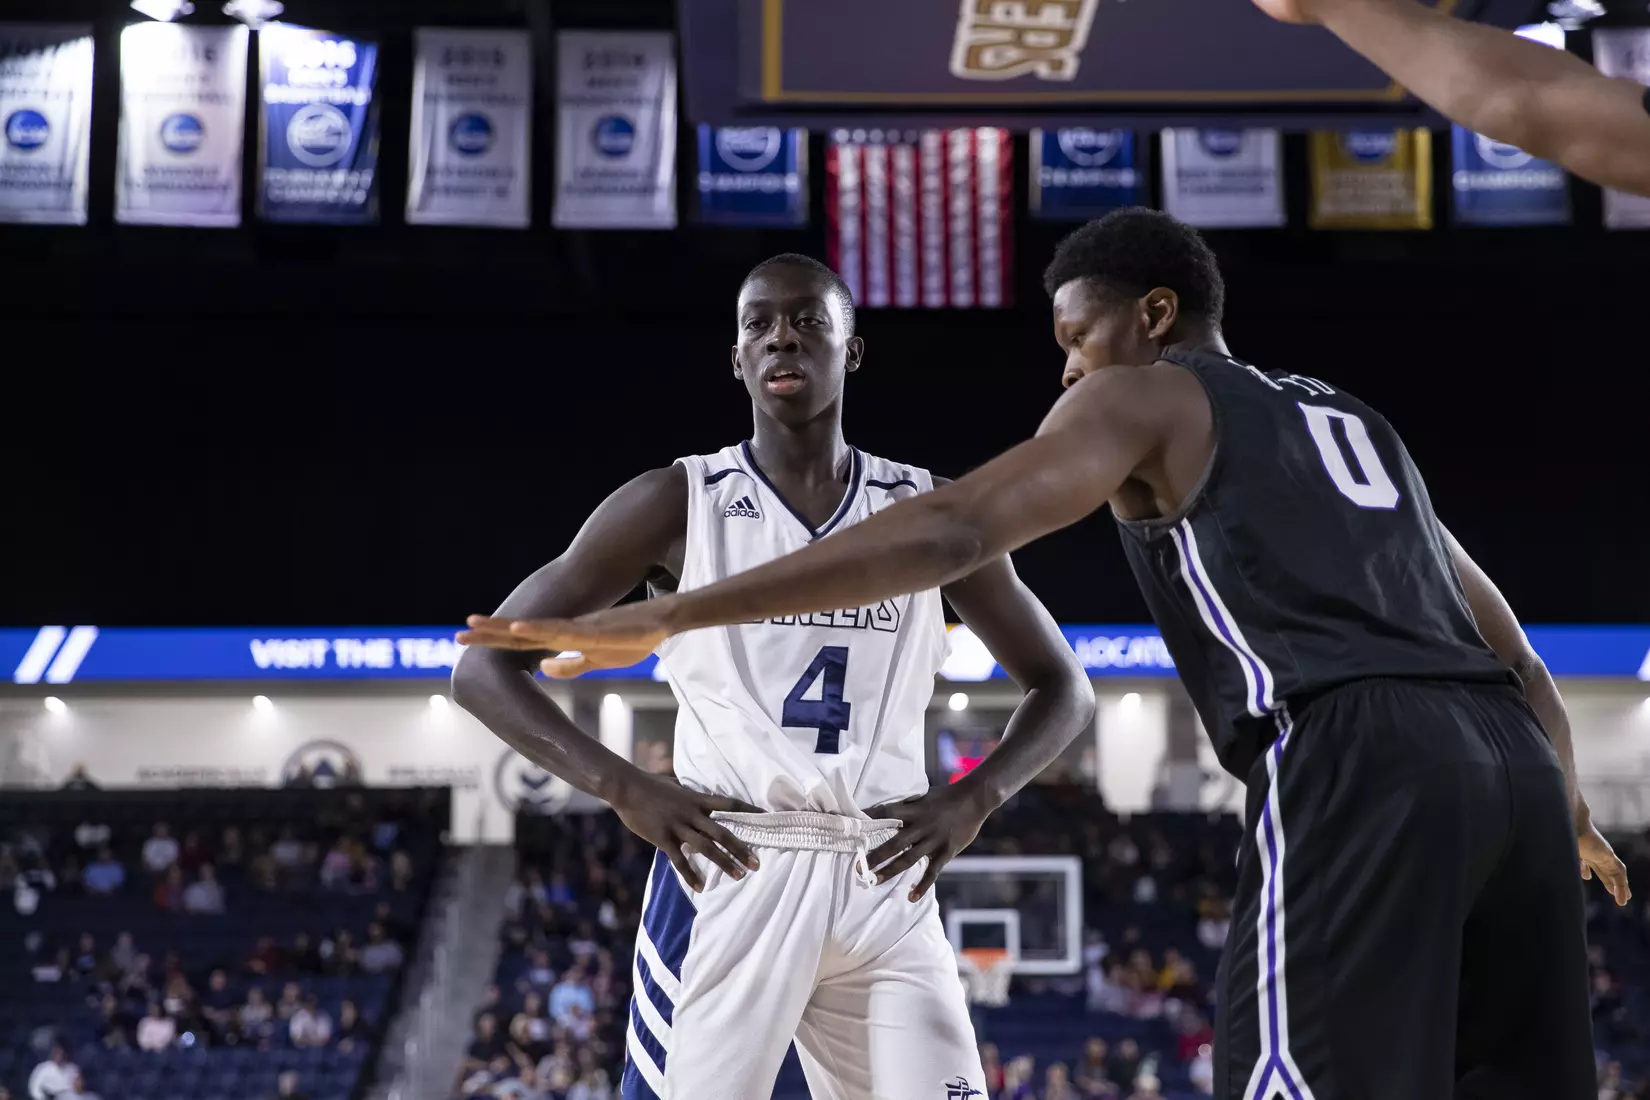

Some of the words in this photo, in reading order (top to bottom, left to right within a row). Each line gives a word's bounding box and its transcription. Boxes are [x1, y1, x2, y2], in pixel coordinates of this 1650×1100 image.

[1295, 401, 1402, 510] 0
[724, 507, 760, 519] adidas
[250, 639, 330, 668] VISIT
[333, 639, 394, 668] THE
[781, 646, 851, 755] 4
